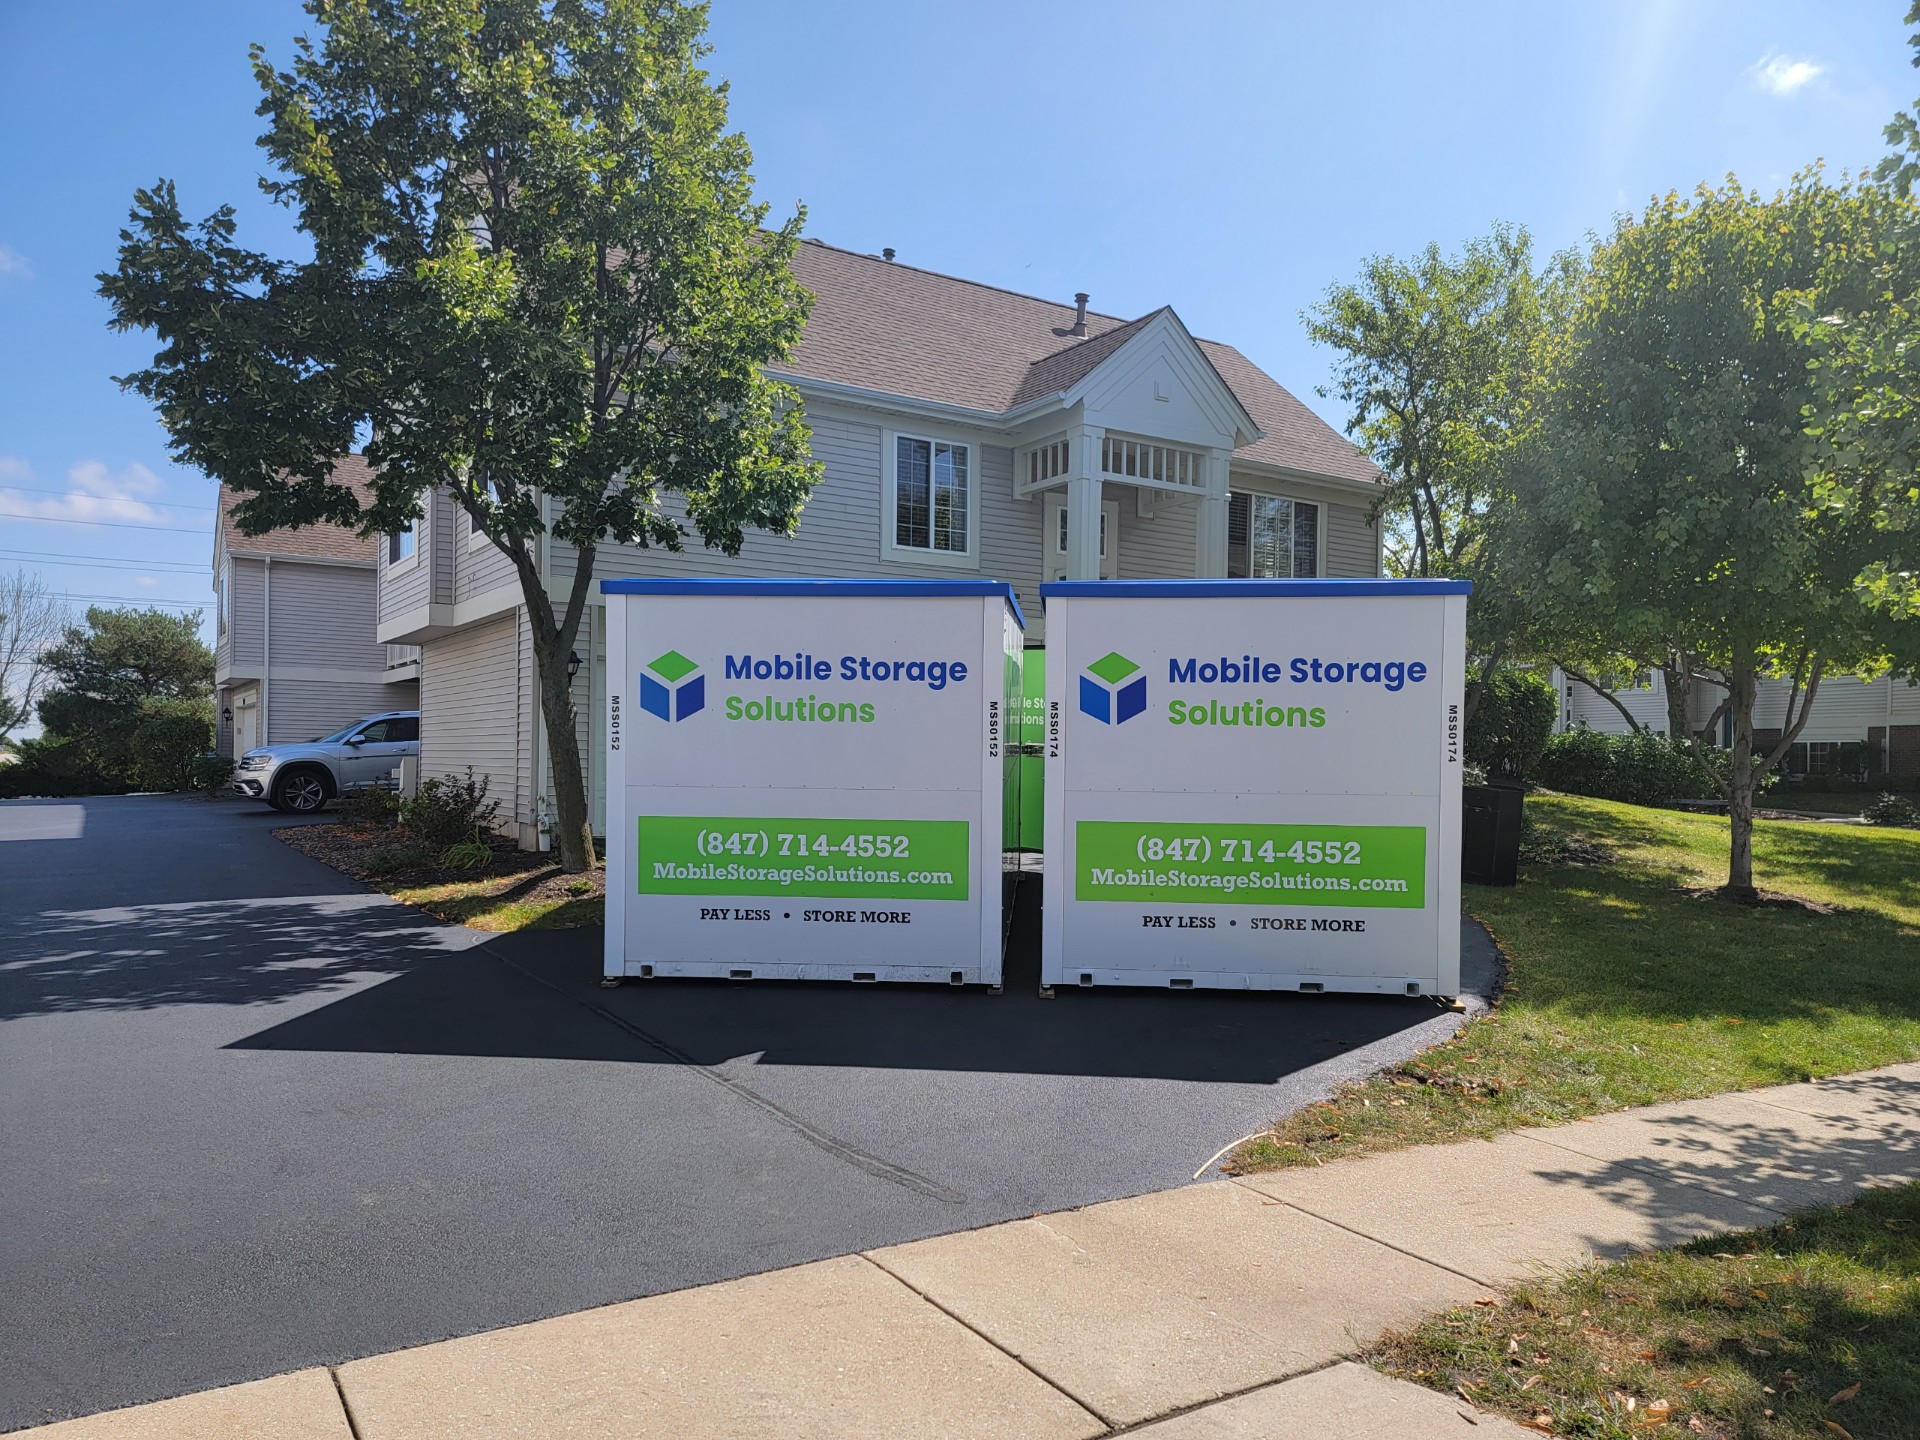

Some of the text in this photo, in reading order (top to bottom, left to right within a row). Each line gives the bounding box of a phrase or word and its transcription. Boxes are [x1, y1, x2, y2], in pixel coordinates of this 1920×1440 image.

[725, 653, 968, 691] Mobile Storage
[1168, 655, 1427, 692] Mobile Storage
[611, 695, 620, 751] MSS0152
[725, 694, 875, 723] Solutions
[1168, 698, 1326, 728] Solutions
[989, 701, 999, 758] MSS0152
[1049, 701, 1059, 759] MSS0174
[1447, 704, 1458, 764] MSS0174
[697, 829, 910, 859] (847) 714-4552
[1136, 835, 1361, 865] (847) 714-4552
[653, 862, 954, 886] MobileStorageSolutions.com
[1090, 868, 1409, 894] MobileStorageSolutions.com
[700, 908, 911, 924] PAY LESS STORE MORE
[1142, 915, 1366, 932] PAY LESS STORE MORE
